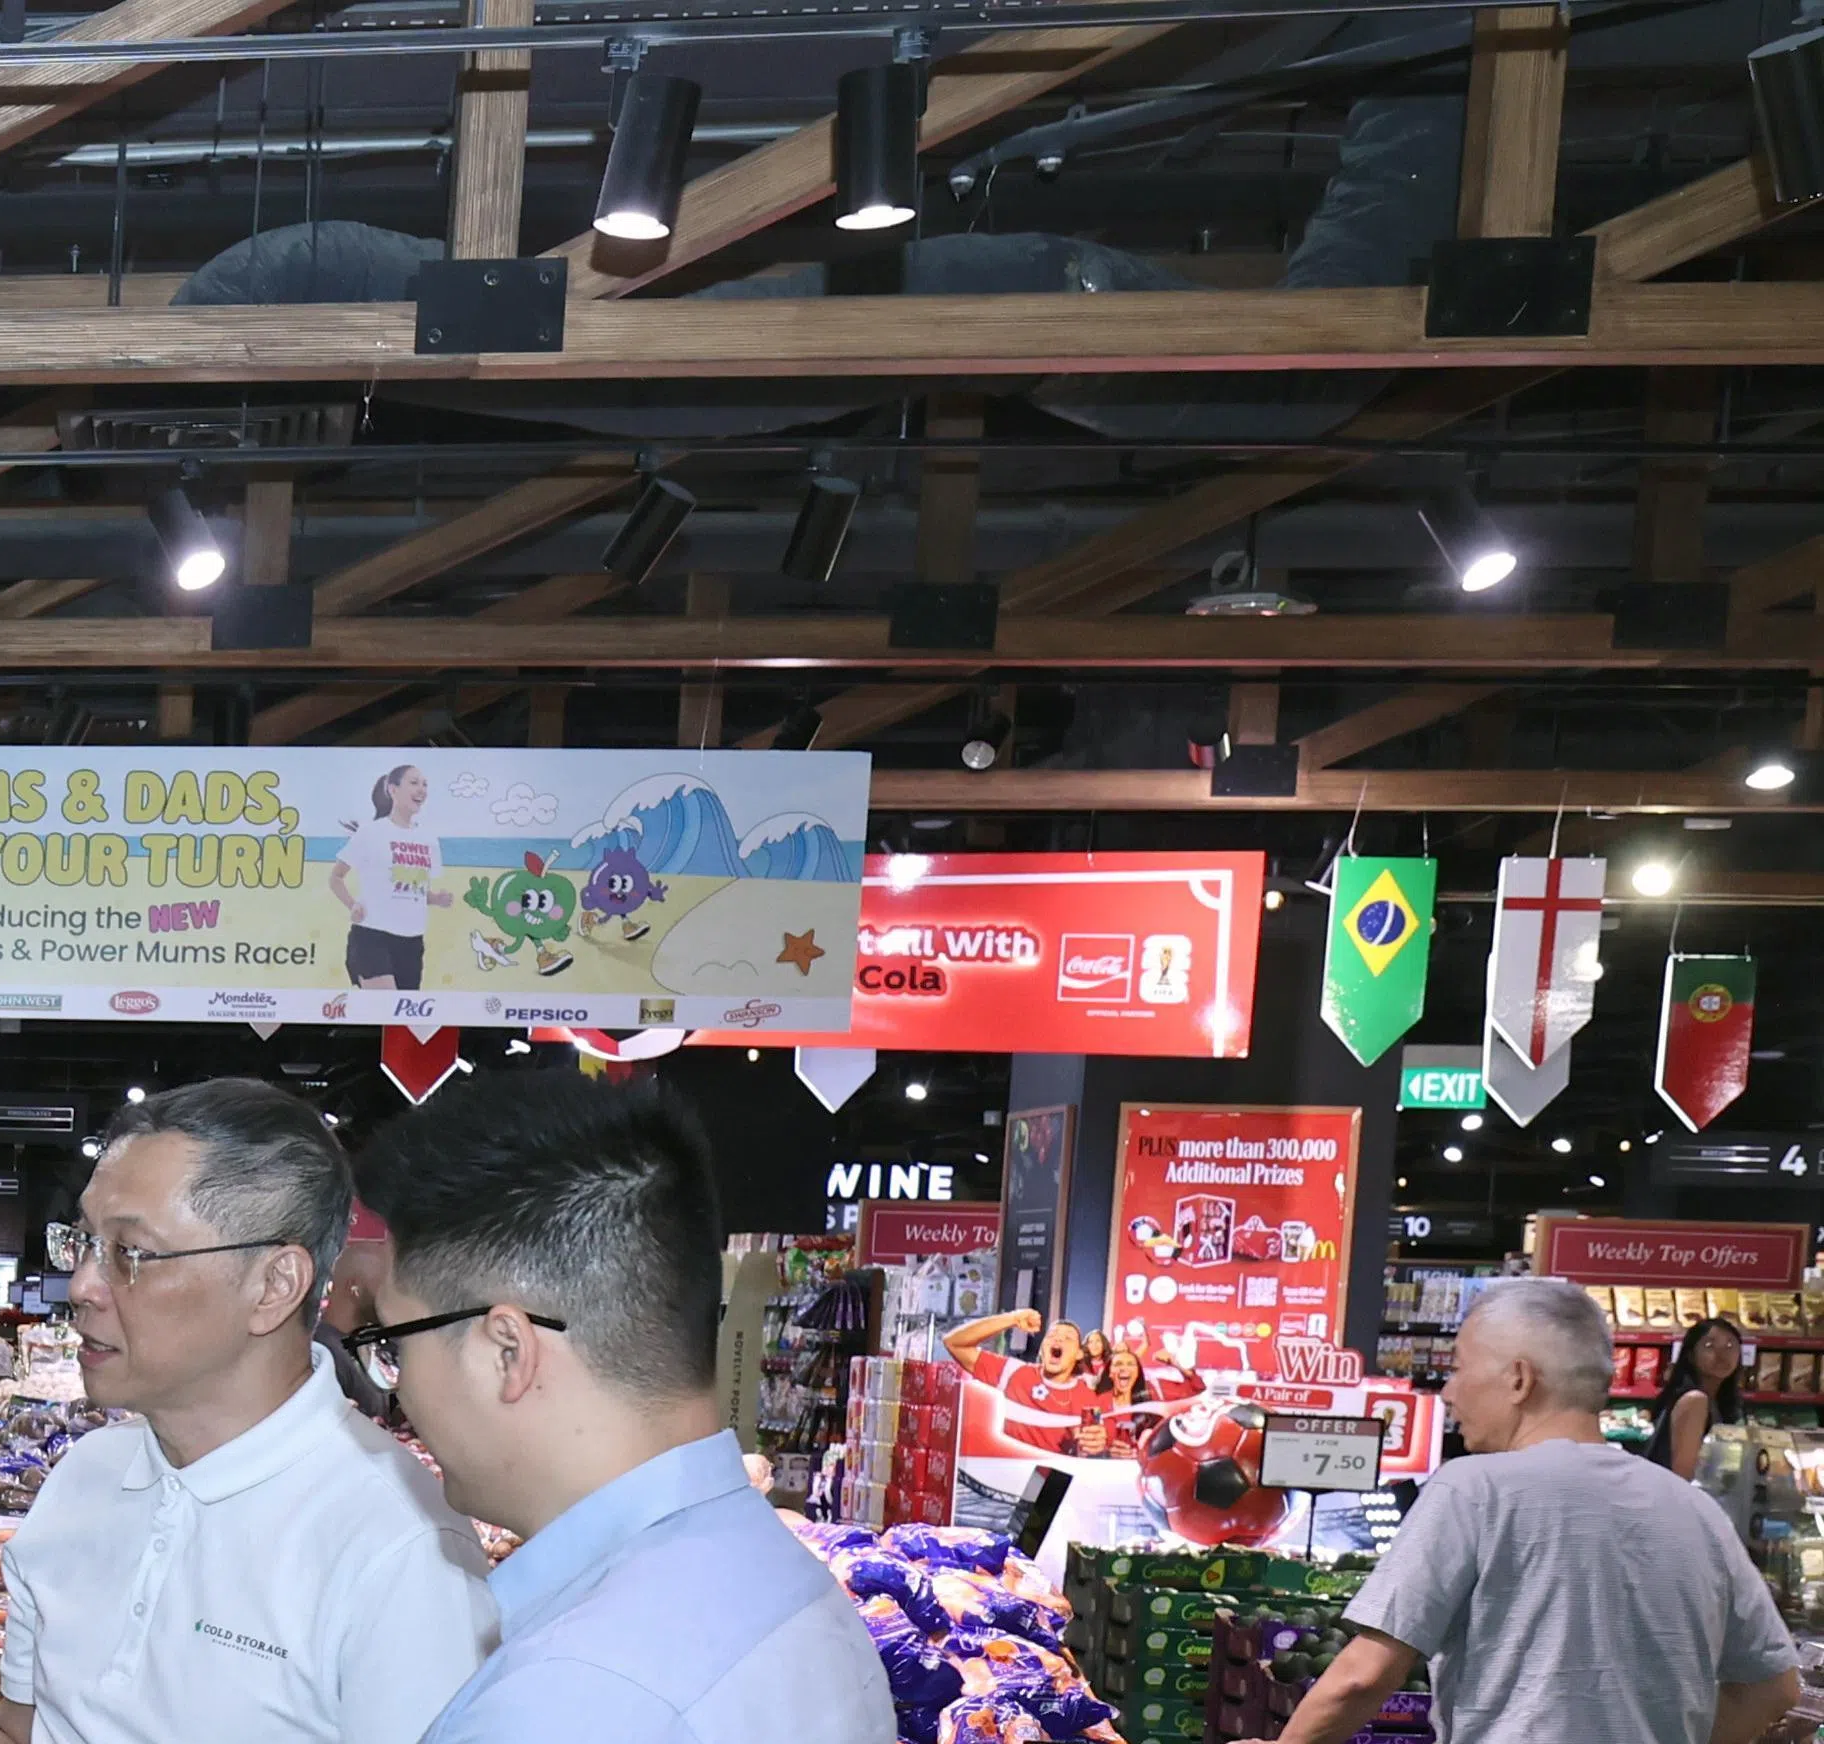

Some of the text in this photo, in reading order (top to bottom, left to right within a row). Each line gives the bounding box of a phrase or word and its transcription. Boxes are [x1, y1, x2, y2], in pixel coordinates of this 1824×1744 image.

[62, 769, 108, 824] &
[124, 770, 299, 834] DADS,
[142, 833, 305, 888] TURN
[96, 906, 141, 929] the
[148, 900, 220, 934] NEW
[11, 941, 31, 961] &
[41, 941, 128, 963] Power
[136, 942, 226, 963] Mums
[234, 942, 316, 965] Race!
[946, 931, 1038, 958] With
[21, 996, 57, 1006] WEST
[394, 998, 435, 1017] P&G
[505, 1007, 588, 1023] PEPSICO
[1424, 1073, 1479, 1103] EXIT
[1139, 1136, 1337, 1162] PLUS more than 300,000
[1779, 1144, 1807, 1176] 4
[1166, 1162, 1304, 1185] Additional Prizes
[905, 1224, 967, 1246] Weekly
[1404, 1216, 1431, 1237] 10
[1587, 1242, 1759, 1266] Weekly Top Offers
[1278, 1342, 1363, 1384] Win
[1251, 1388, 1310, 1402] A Pair of
[1295, 1419, 1358, 1434] OFFER
[203, 1623, 234, 1641] COLD
[235, 1632, 289, 1660] STORAGE
